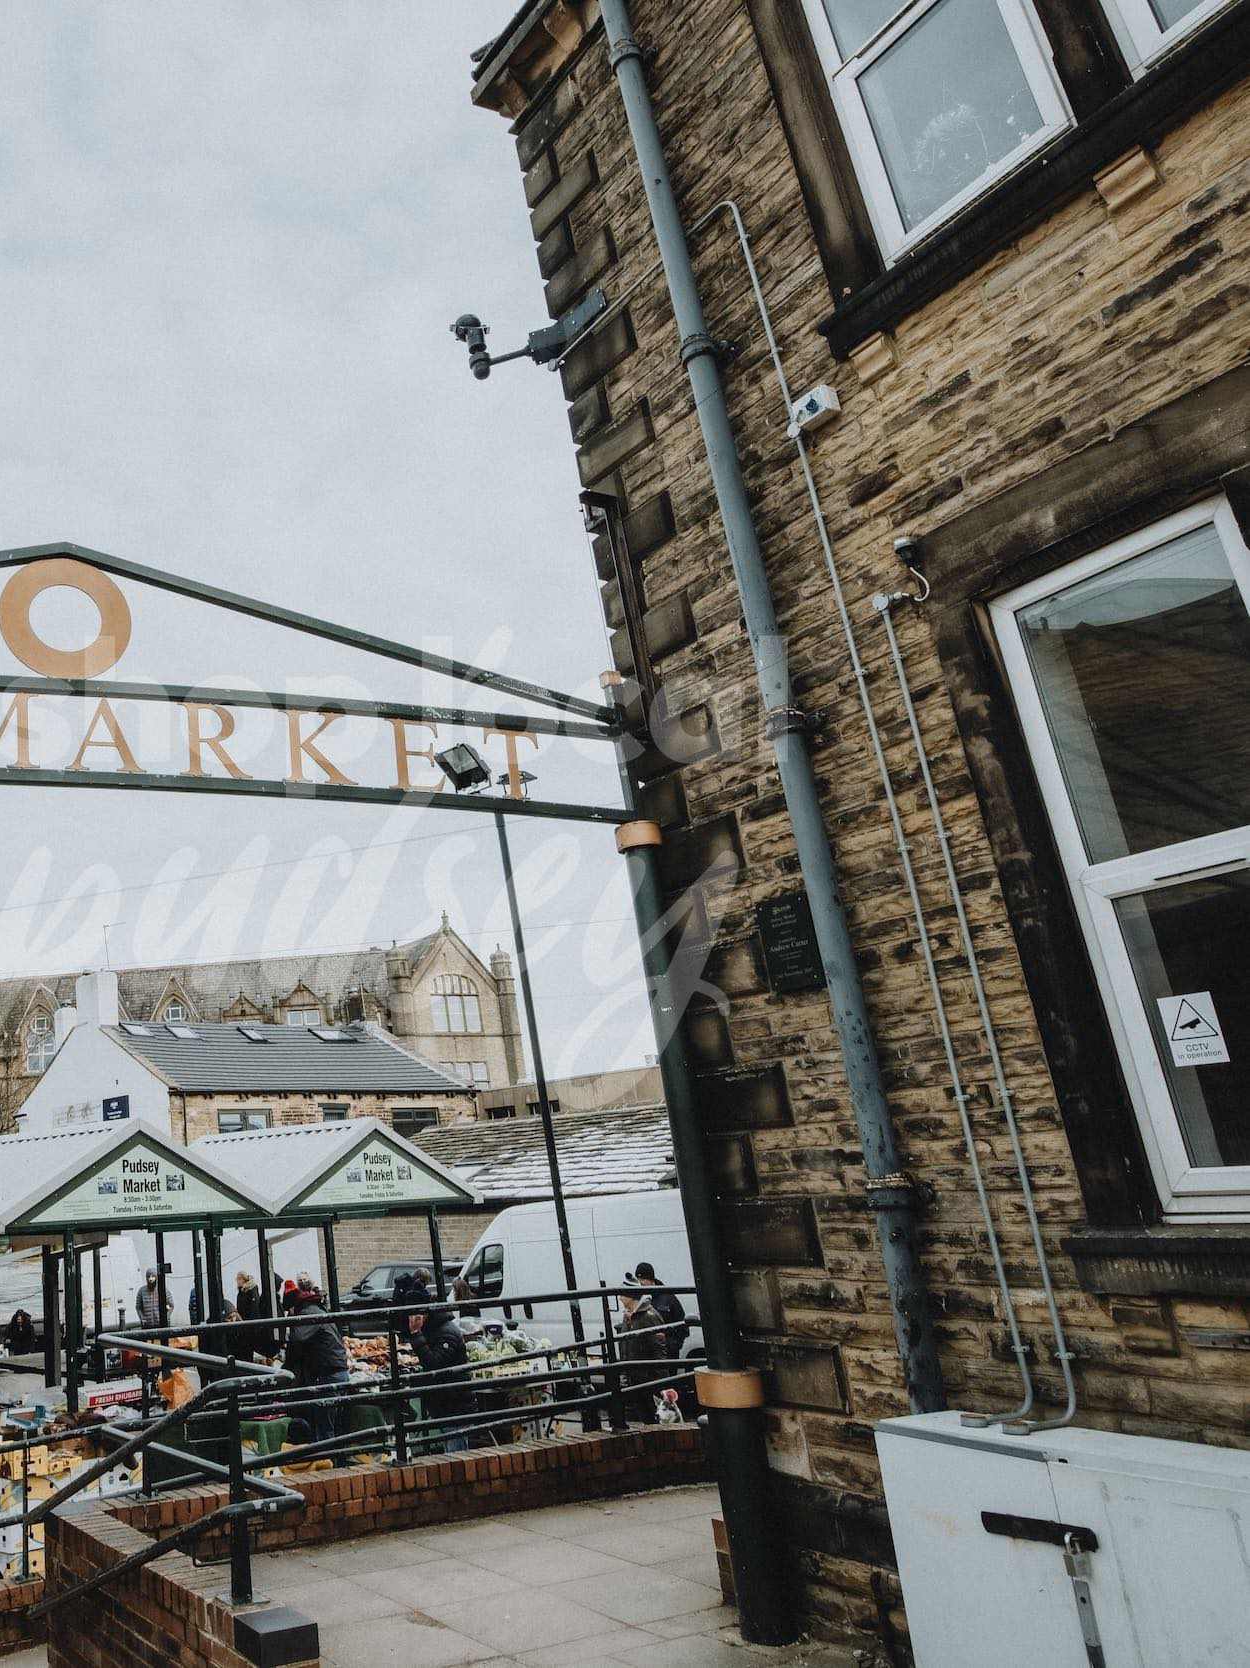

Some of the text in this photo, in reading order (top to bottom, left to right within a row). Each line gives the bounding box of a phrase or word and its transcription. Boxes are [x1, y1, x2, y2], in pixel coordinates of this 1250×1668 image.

[1185, 1043, 1209, 1052] CCTV
[1187, 1051, 1222, 1060] operation
[363, 1152, 391, 1166] Pudsey
[122, 1159, 159, 1175] Pudsey
[365, 1169, 394, 1181] Market
[123, 1179, 161, 1193] Market
